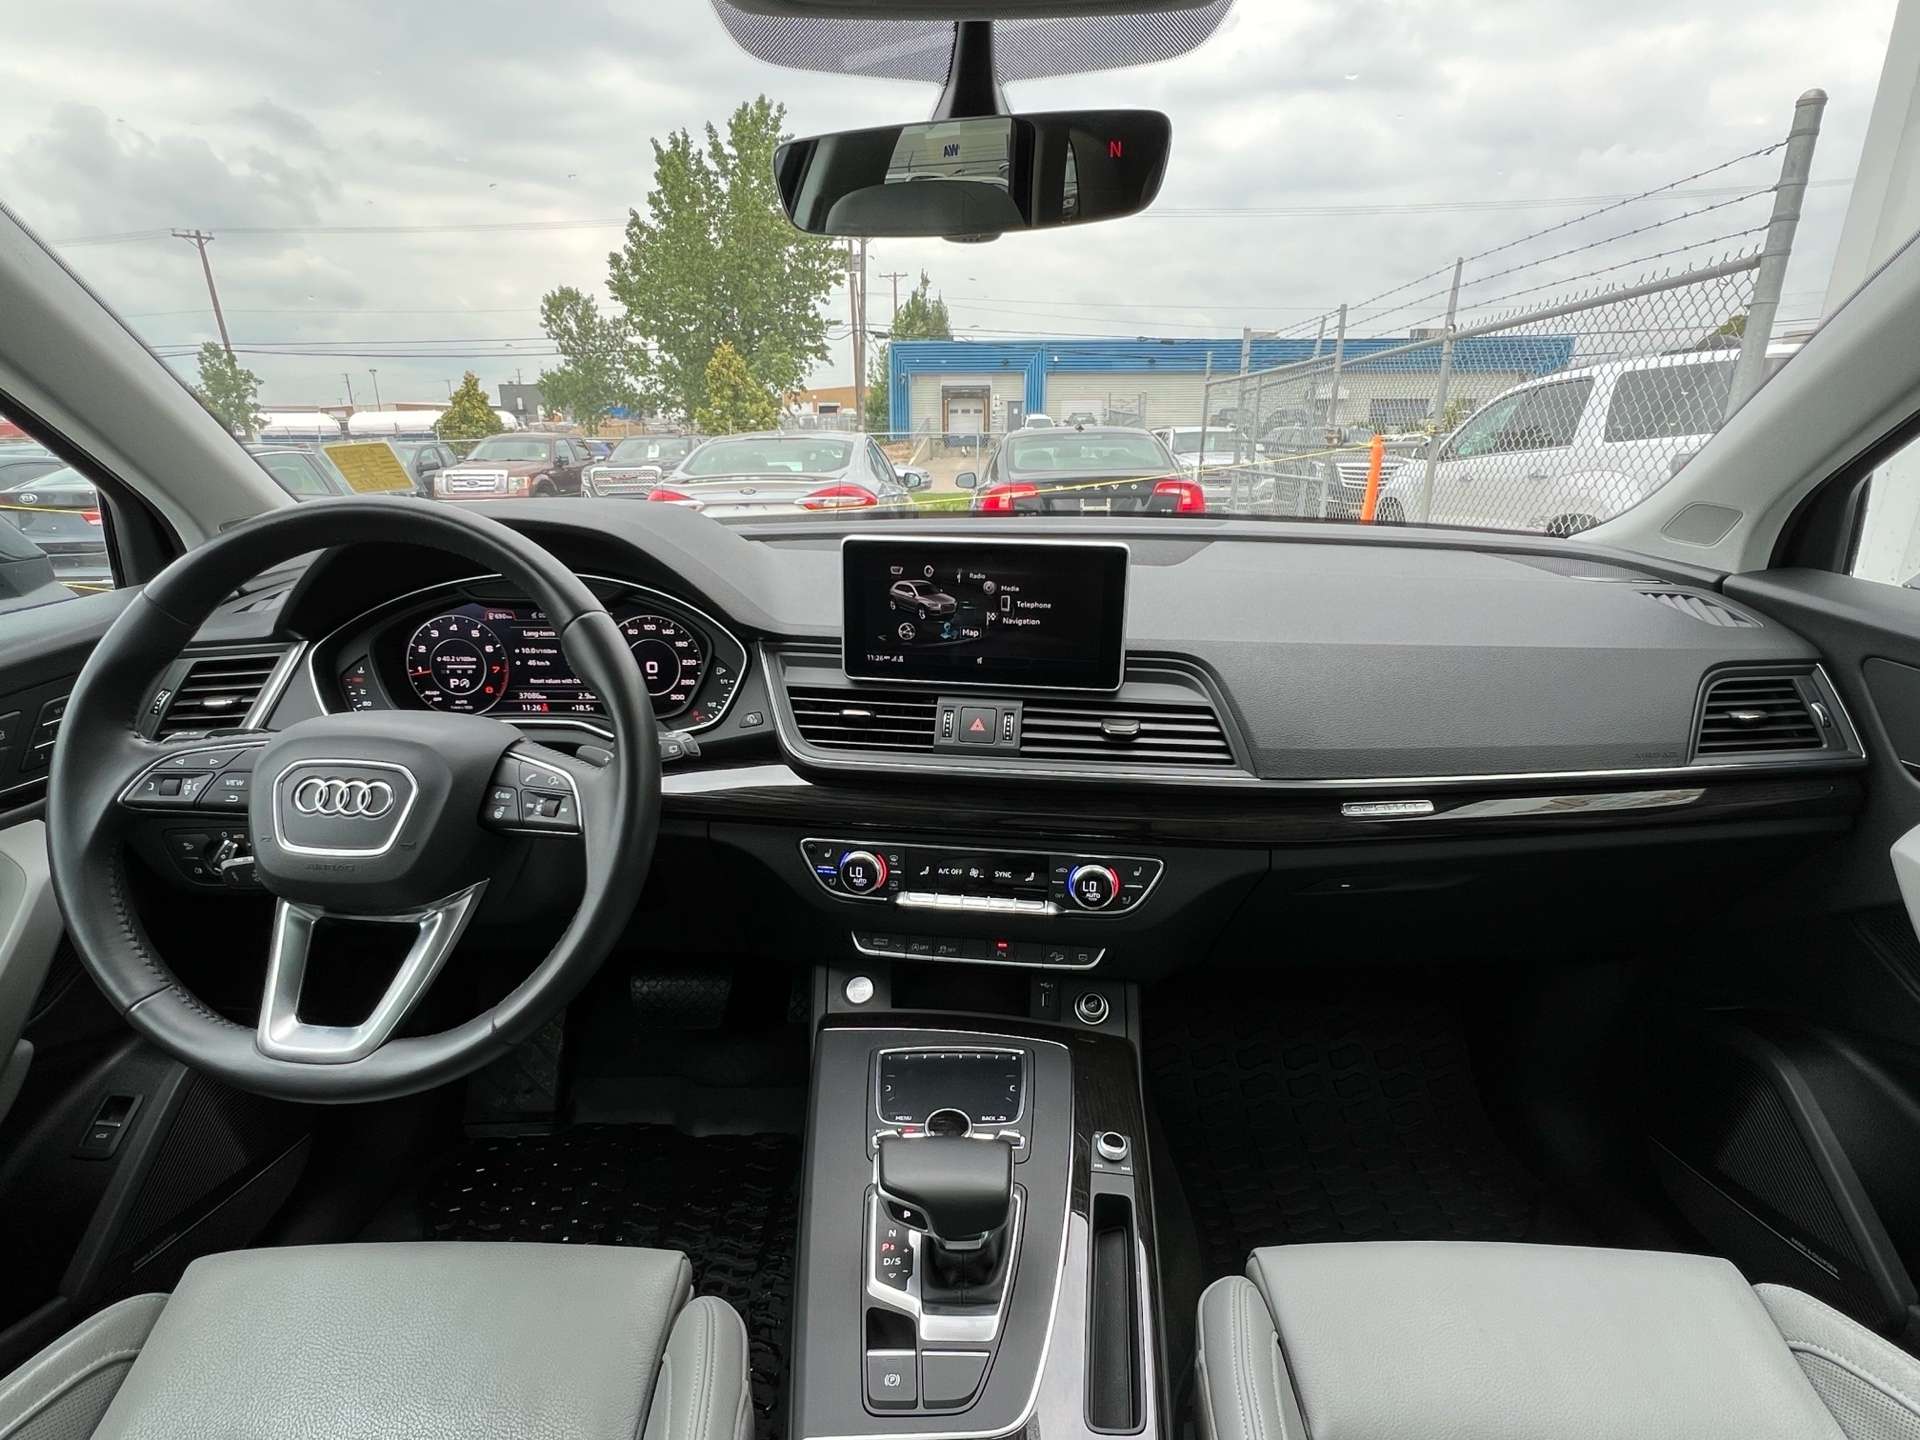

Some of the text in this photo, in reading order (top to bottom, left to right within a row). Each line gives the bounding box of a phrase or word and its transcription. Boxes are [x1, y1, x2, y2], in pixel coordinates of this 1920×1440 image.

[1110, 141, 1122, 157] N
[1017, 601, 1051, 609] Telephone
[1002, 617, 1041, 626] Navigation
[962, 629, 979, 637] Map
[418, 645, 426, 653] 2
[485, 645, 494, 653] 6
[646, 661, 658, 673] 0
[449, 678, 459, 688] P
[903, 1210, 911, 1218] P
[888, 1229, 897, 1237] N
[883, 1257, 902, 1266] D/S
